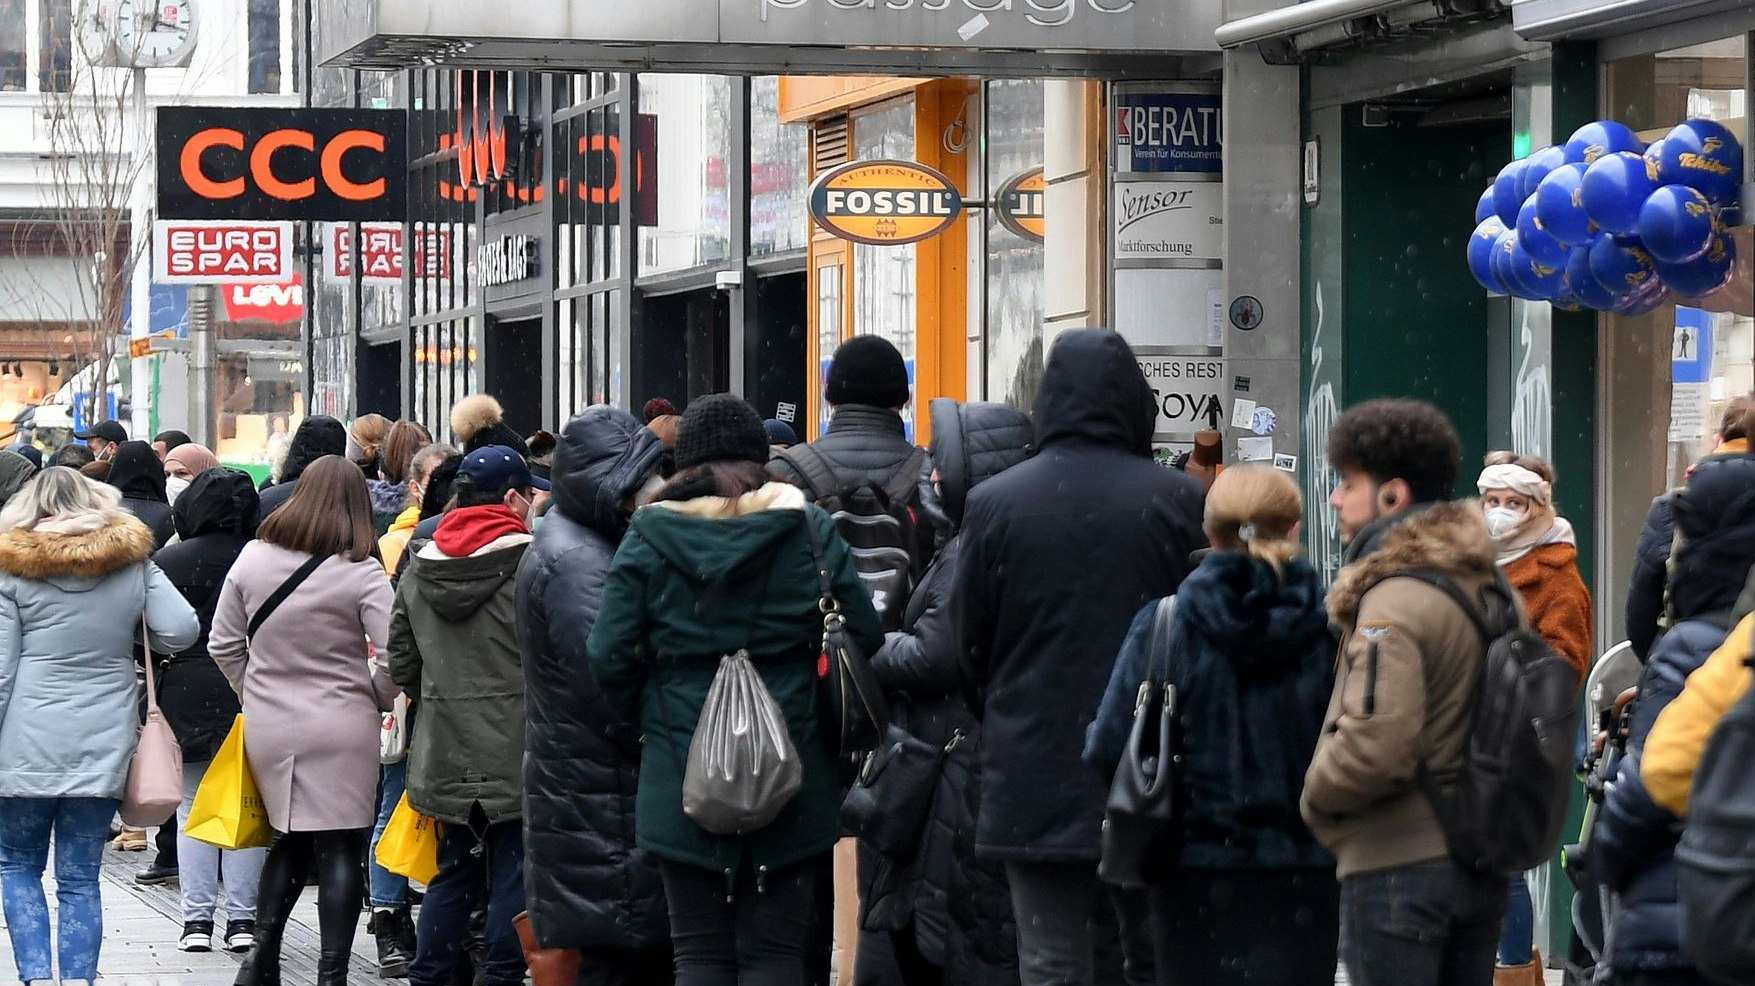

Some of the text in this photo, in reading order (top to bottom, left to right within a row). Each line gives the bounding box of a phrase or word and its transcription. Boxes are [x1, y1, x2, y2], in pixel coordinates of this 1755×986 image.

[1135, 149, 1156, 158] Verein
[1158, 149, 1169, 158] für
[180, 127, 386, 201] CCC
[840, 168, 936, 187] AUTHENTIC
[826, 190, 951, 214] FOSSIL
[1119, 188, 1193, 226] Sensor
[171, 231, 277, 250] EURO
[1118, 240, 1193, 256] Marktforschung
[171, 252, 277, 272] SPAR
[1186, 362, 1223, 378] REST
